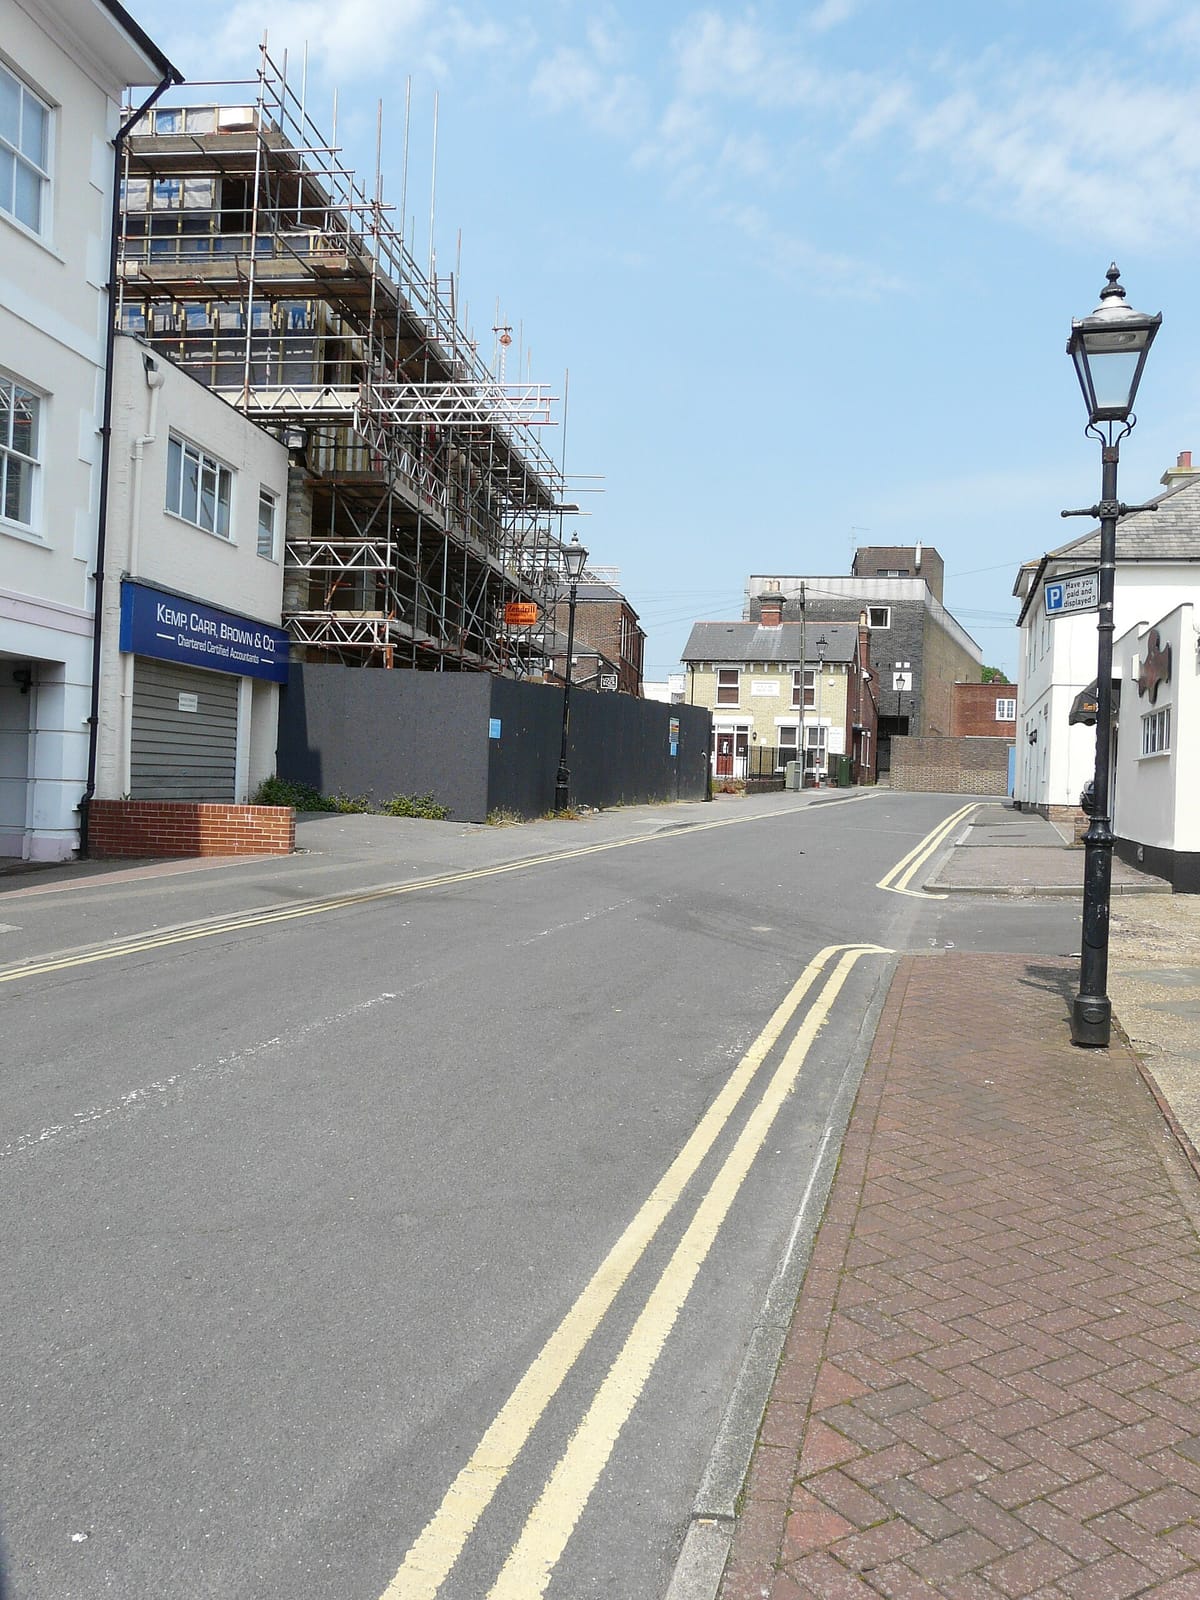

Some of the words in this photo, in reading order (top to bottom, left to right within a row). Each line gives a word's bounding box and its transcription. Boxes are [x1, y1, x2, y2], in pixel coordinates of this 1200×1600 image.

[1065, 581, 1080, 589] Have
[1082, 579, 1093, 587] you
[1066, 589, 1079, 599] paid
[1050, 588, 1060, 608] P
[156, 602, 188, 631] KEMP,
[190, 613, 219, 639] CARR,
[220, 622, 253, 647] BROWN
[254, 632, 262, 649] &
[177, 633, 207, 652] Chartered
[206, 641, 230, 658] Certified
[229, 647, 260, 665] Accountants
